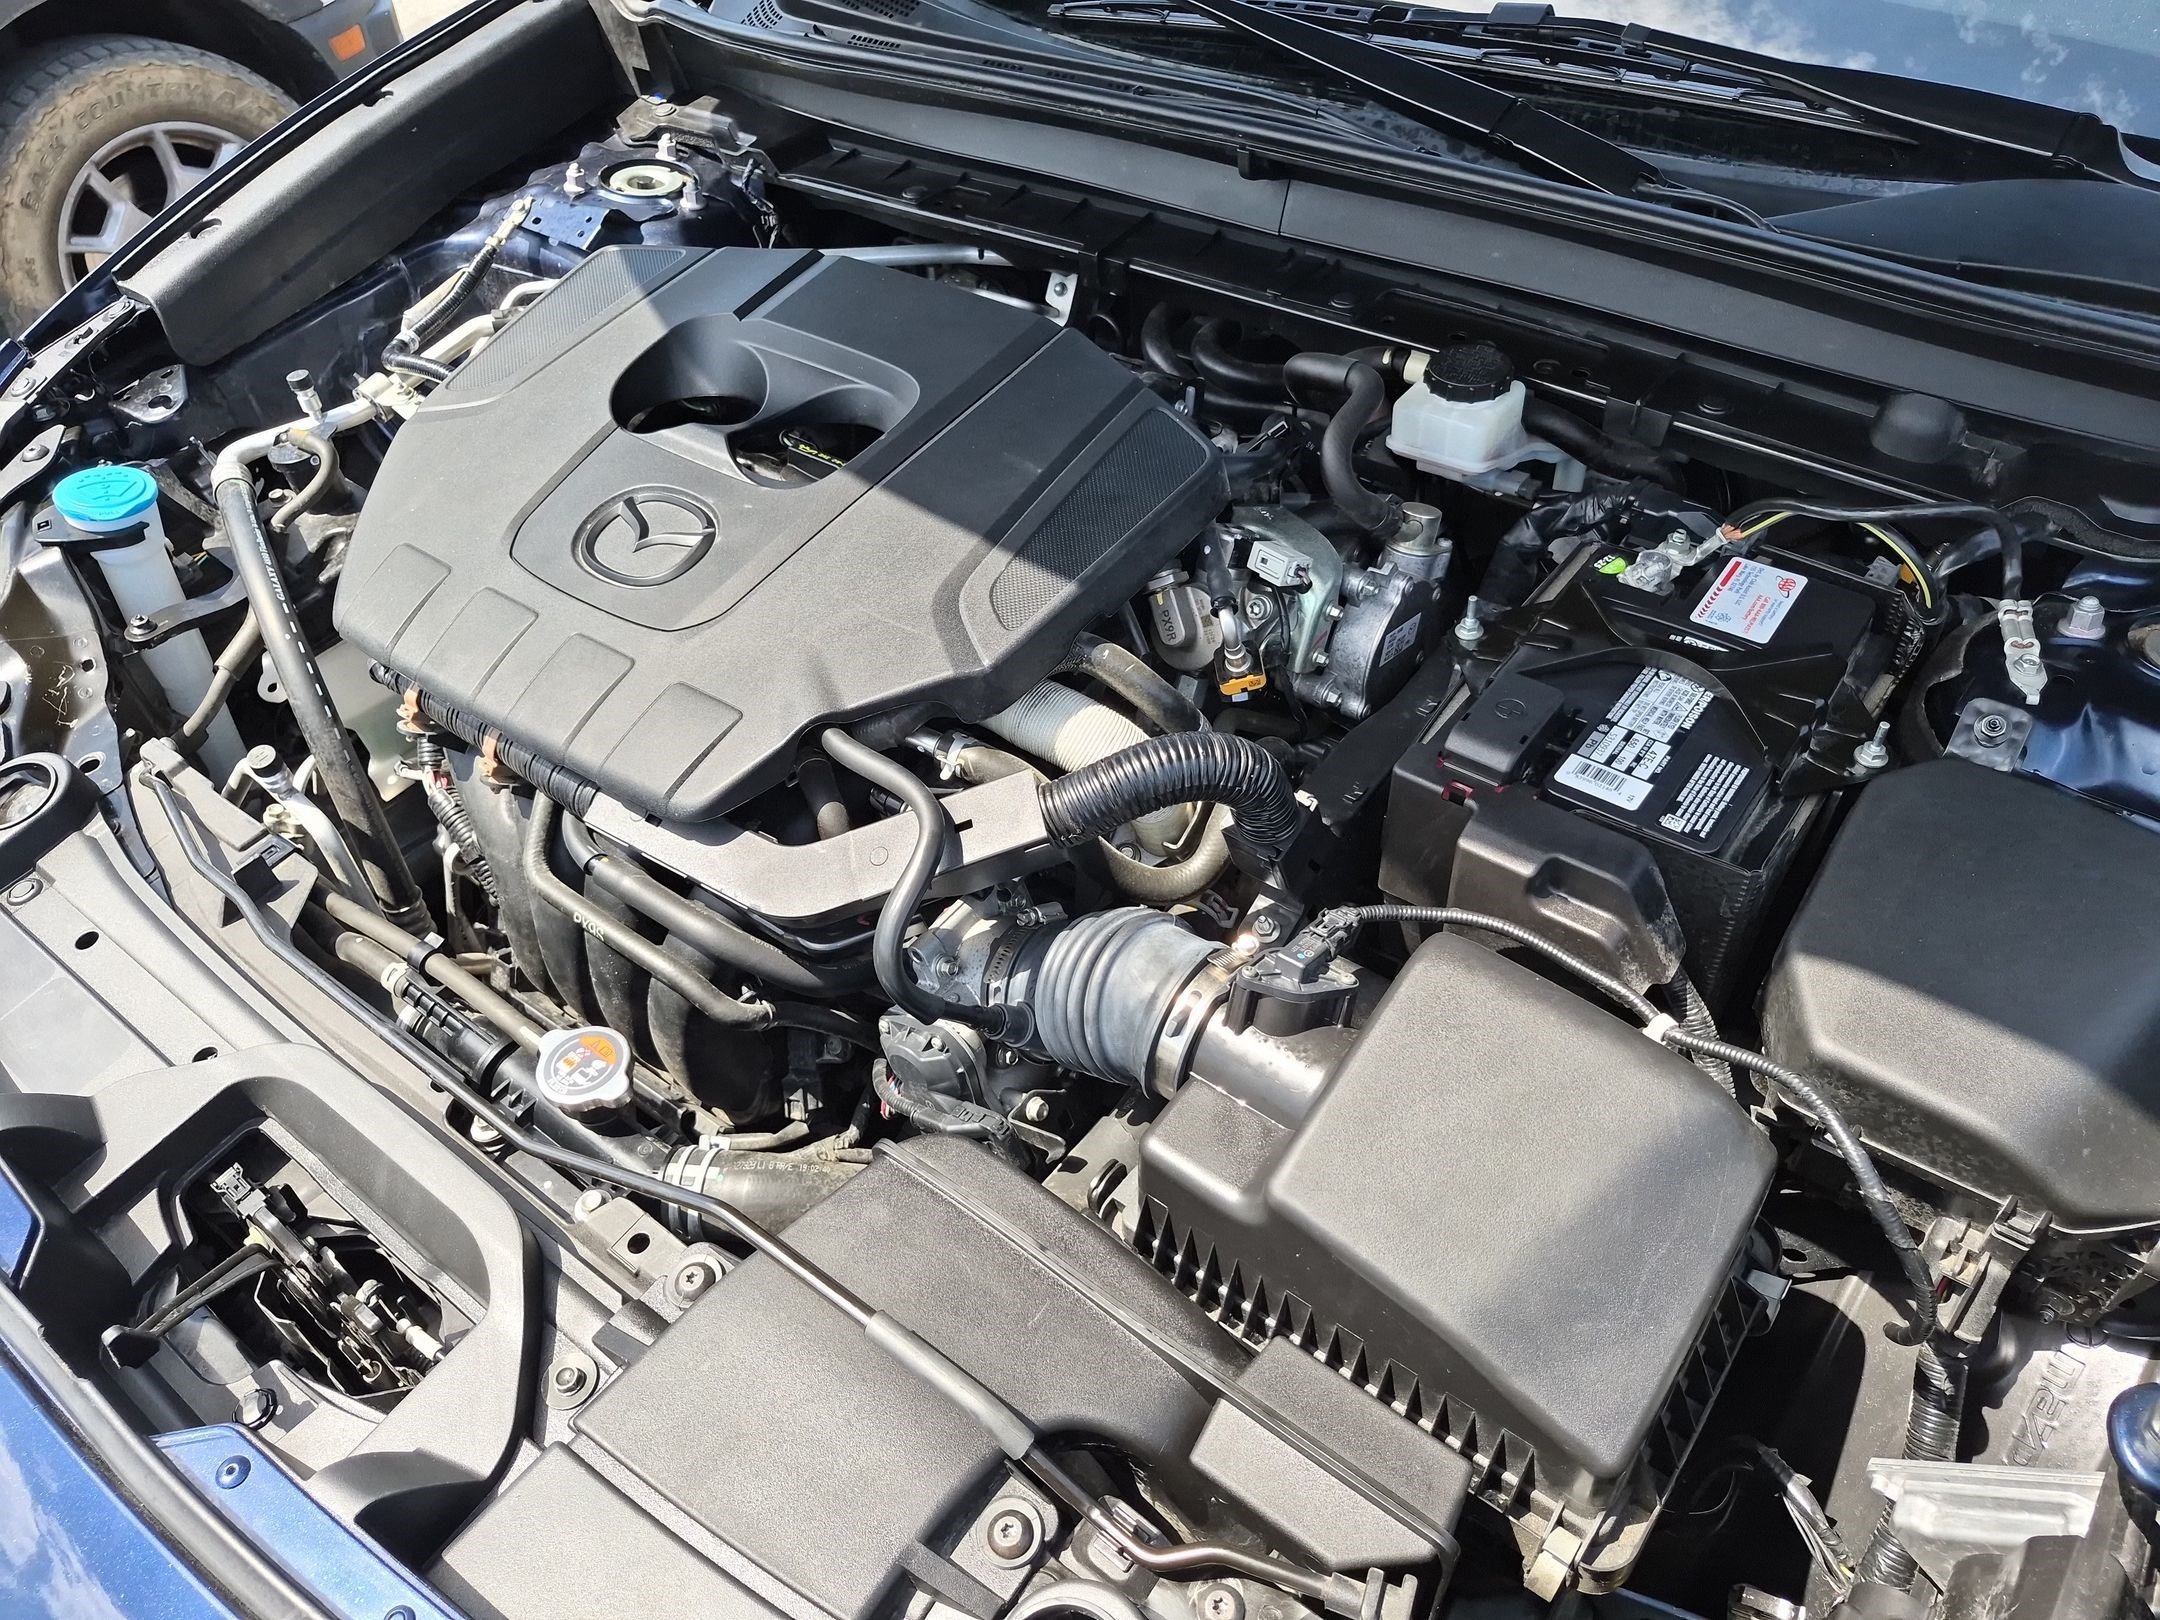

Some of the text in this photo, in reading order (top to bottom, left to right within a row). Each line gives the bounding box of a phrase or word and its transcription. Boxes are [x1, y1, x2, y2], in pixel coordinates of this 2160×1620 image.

[73, 81, 202, 131] COUNTRY
[266, 565, 286, 601] GALAXY
[1161, 609, 1177, 642] PX9R
[1584, 738, 1598, 749] Pb
[1594, 731, 1617, 756] 5310937
[1627, 737, 1640, 748] 650
[1638, 750, 1658, 769] 47E-C
[2004, 1348, 2086, 1467] mazd
